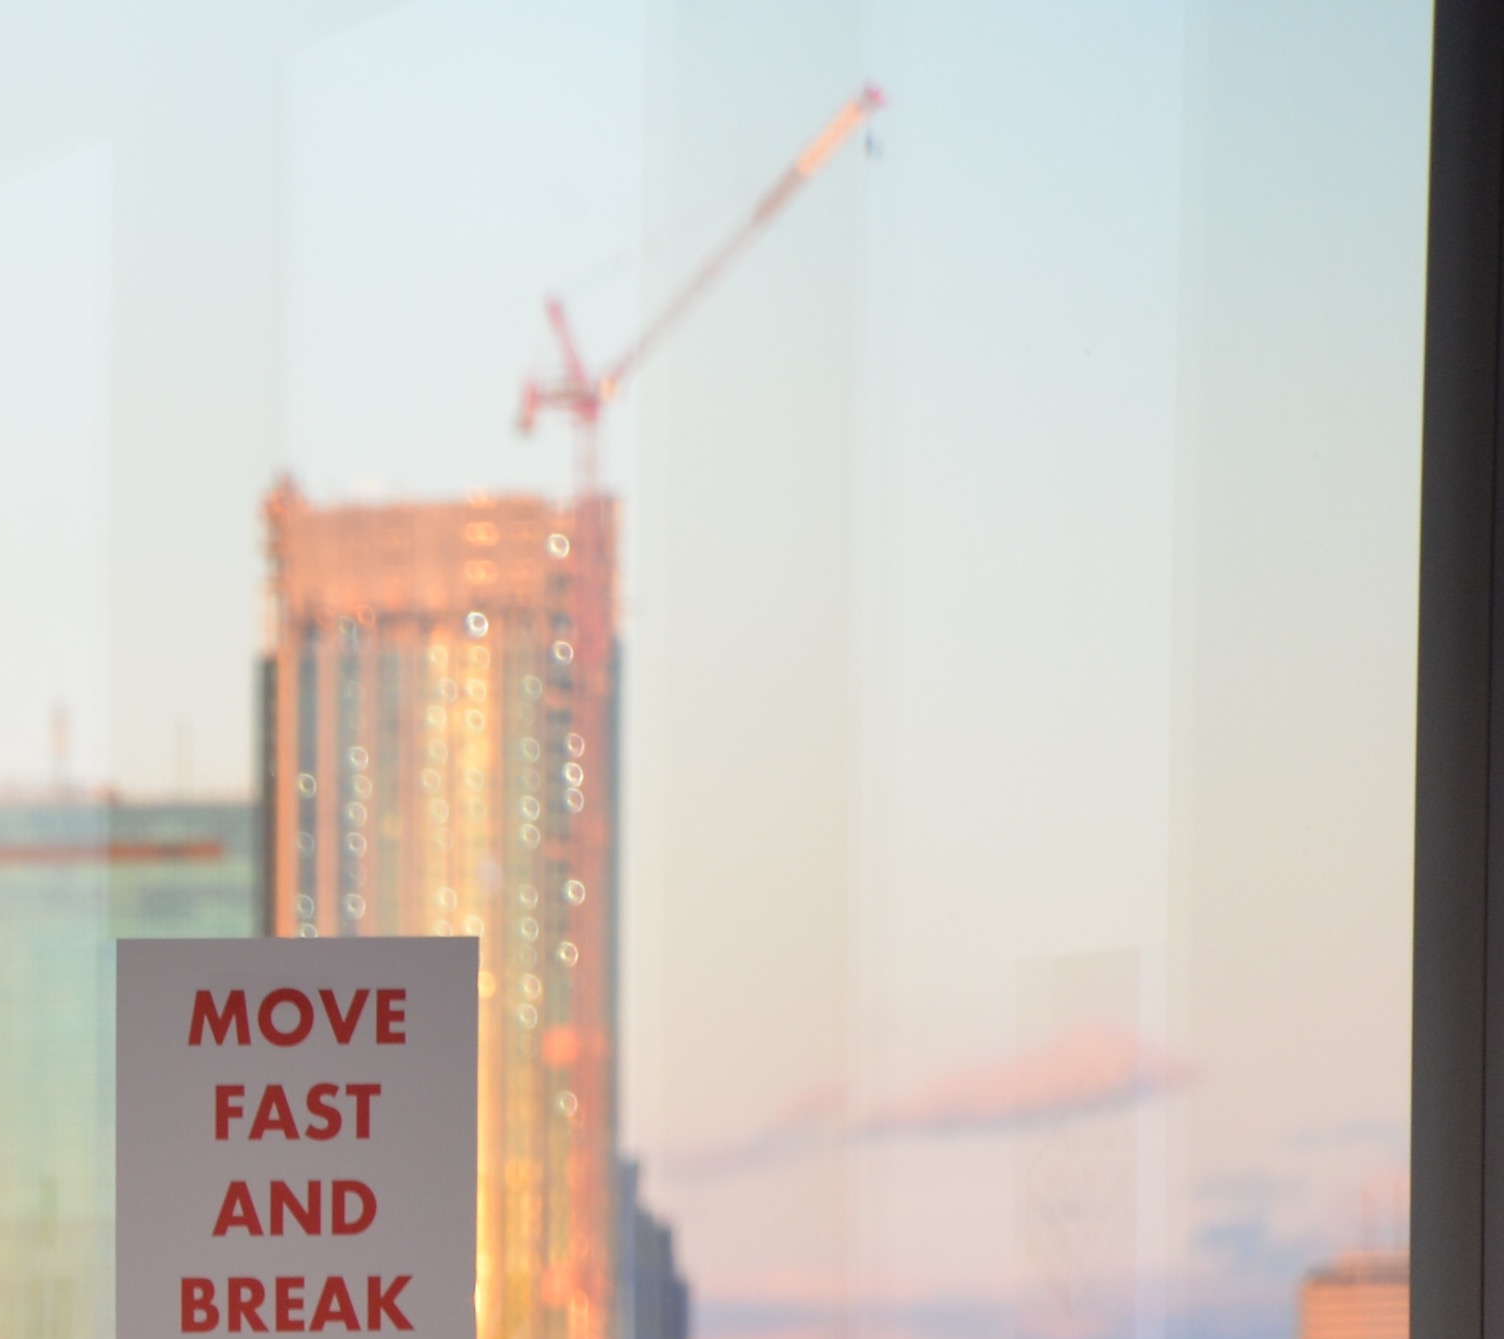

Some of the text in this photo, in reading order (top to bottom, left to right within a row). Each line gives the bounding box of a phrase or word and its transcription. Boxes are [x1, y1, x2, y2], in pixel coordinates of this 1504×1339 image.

[188, 988, 406, 1046] MOVE
[215, 1084, 381, 1141] FAST
[212, 1180, 377, 1237] AND
[181, 1275, 413, 1333] BREAK
